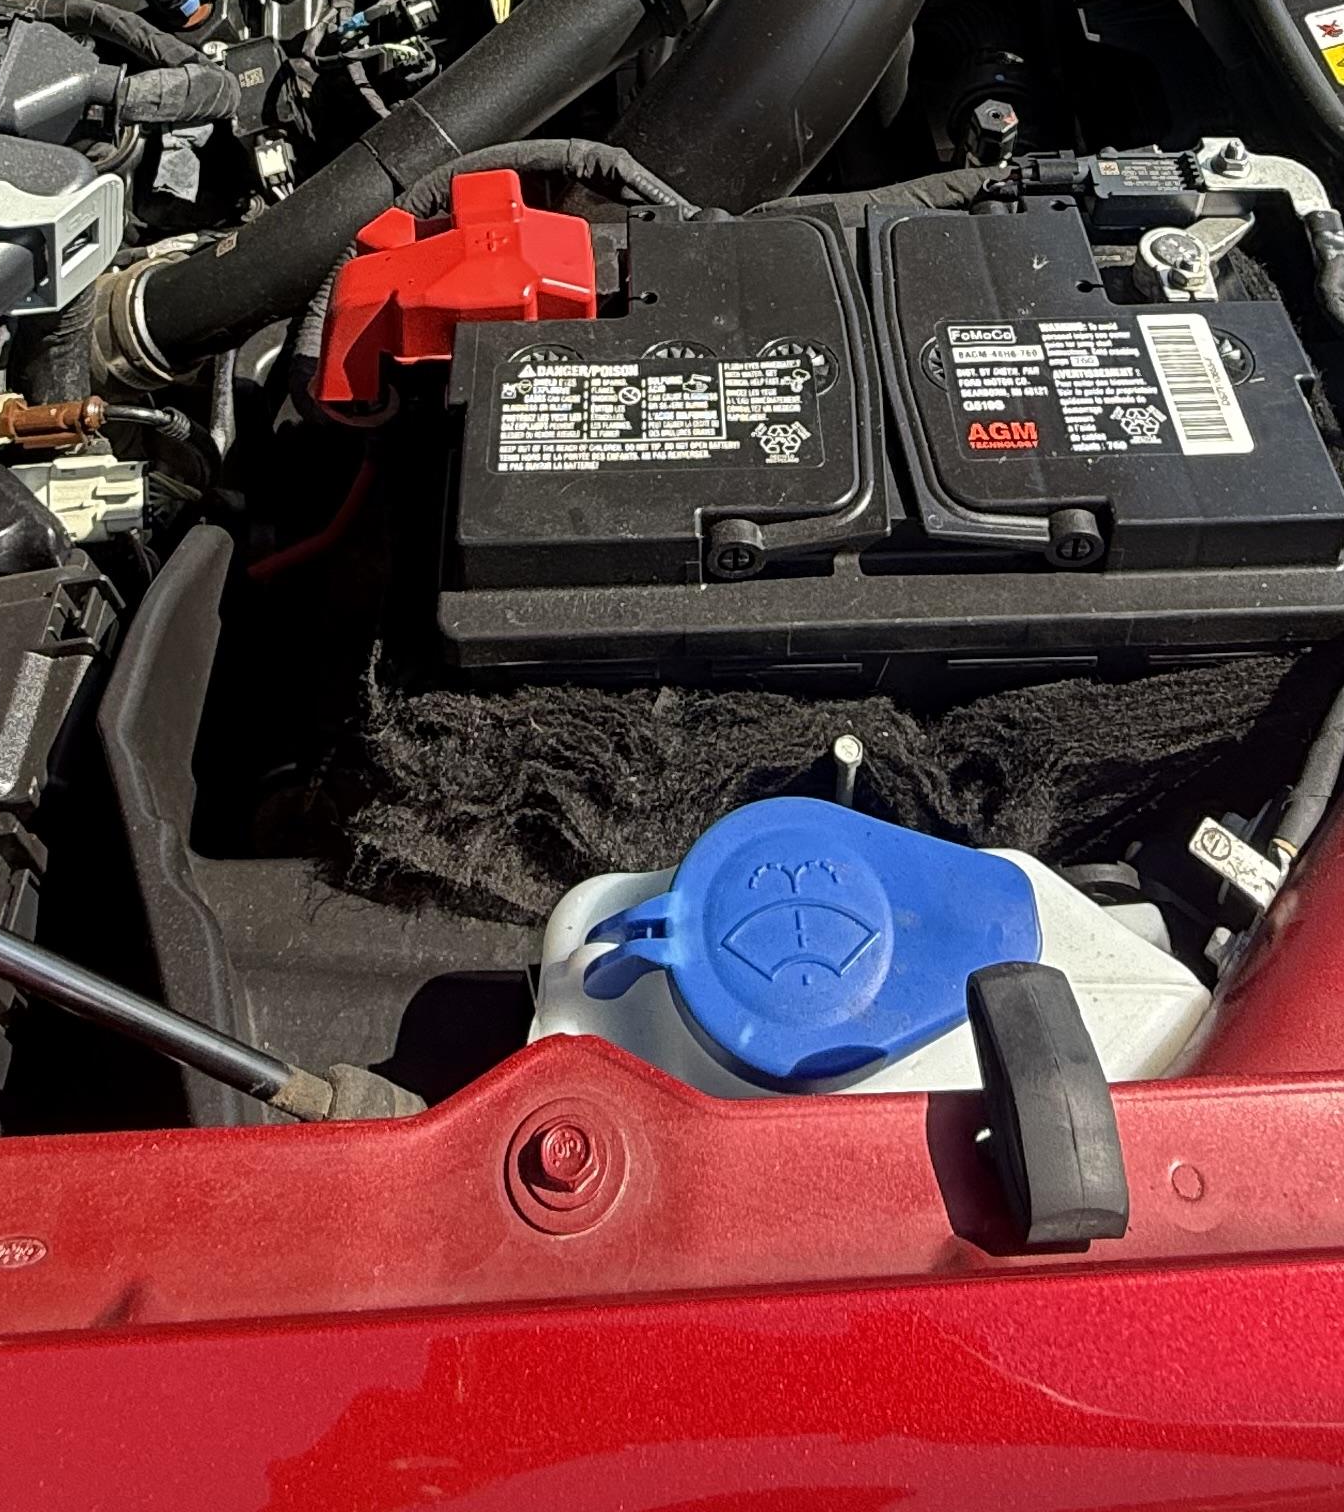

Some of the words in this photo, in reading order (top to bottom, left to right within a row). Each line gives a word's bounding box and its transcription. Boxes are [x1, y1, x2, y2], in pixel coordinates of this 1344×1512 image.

[950, 328, 1012, 341] FoMoCo
[536, 363, 639, 378] DANGER/POISON
[965, 421, 1038, 440] AGM
